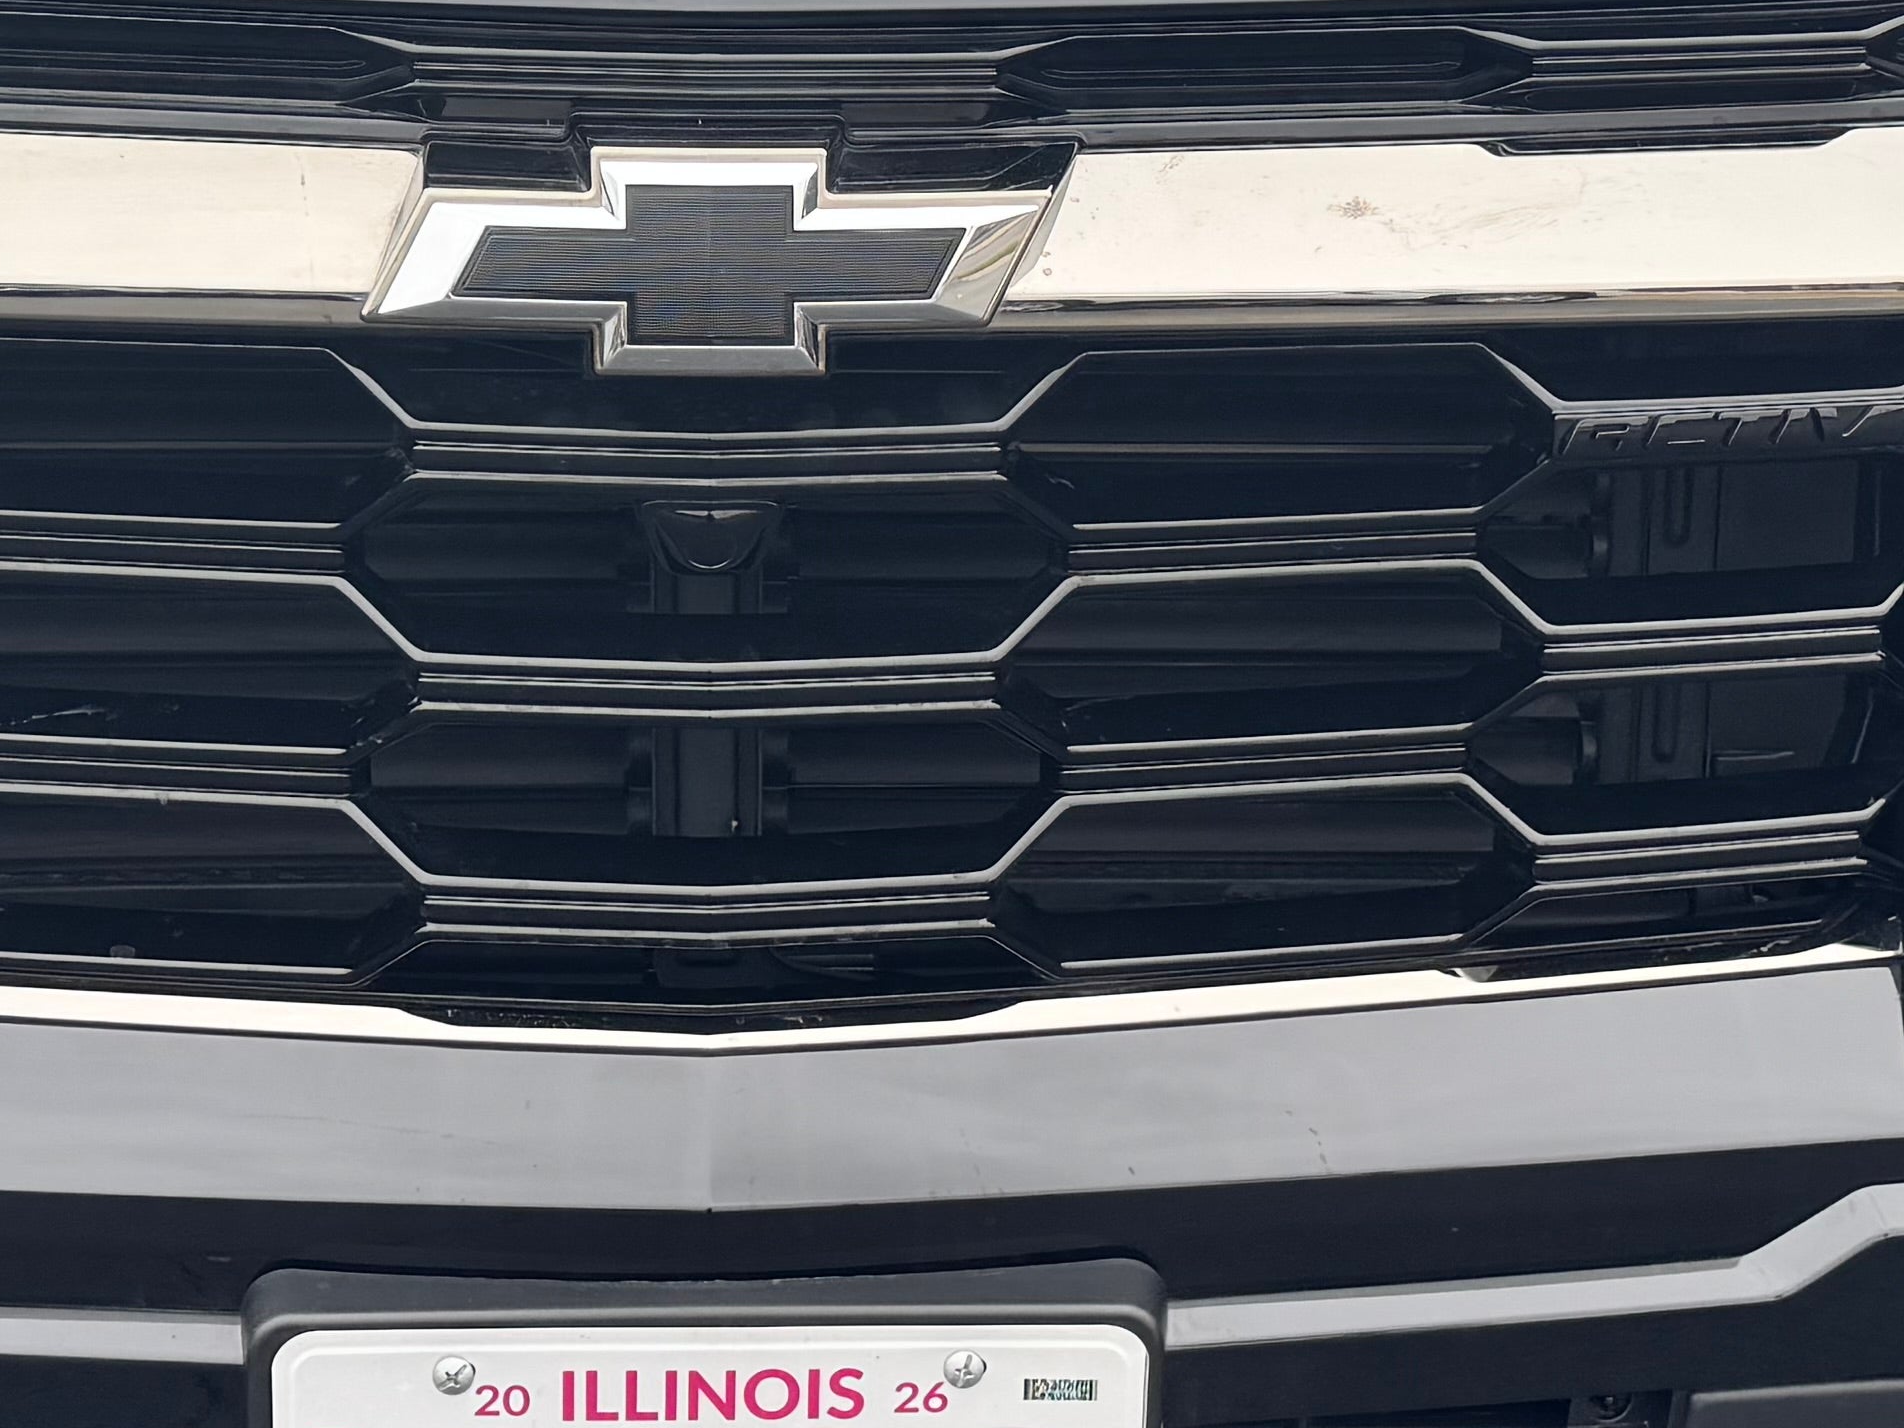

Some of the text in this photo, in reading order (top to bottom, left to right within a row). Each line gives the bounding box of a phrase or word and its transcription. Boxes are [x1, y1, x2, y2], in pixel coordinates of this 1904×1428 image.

[475, 1368, 949, 1422] 20 ILLINOIS 26
